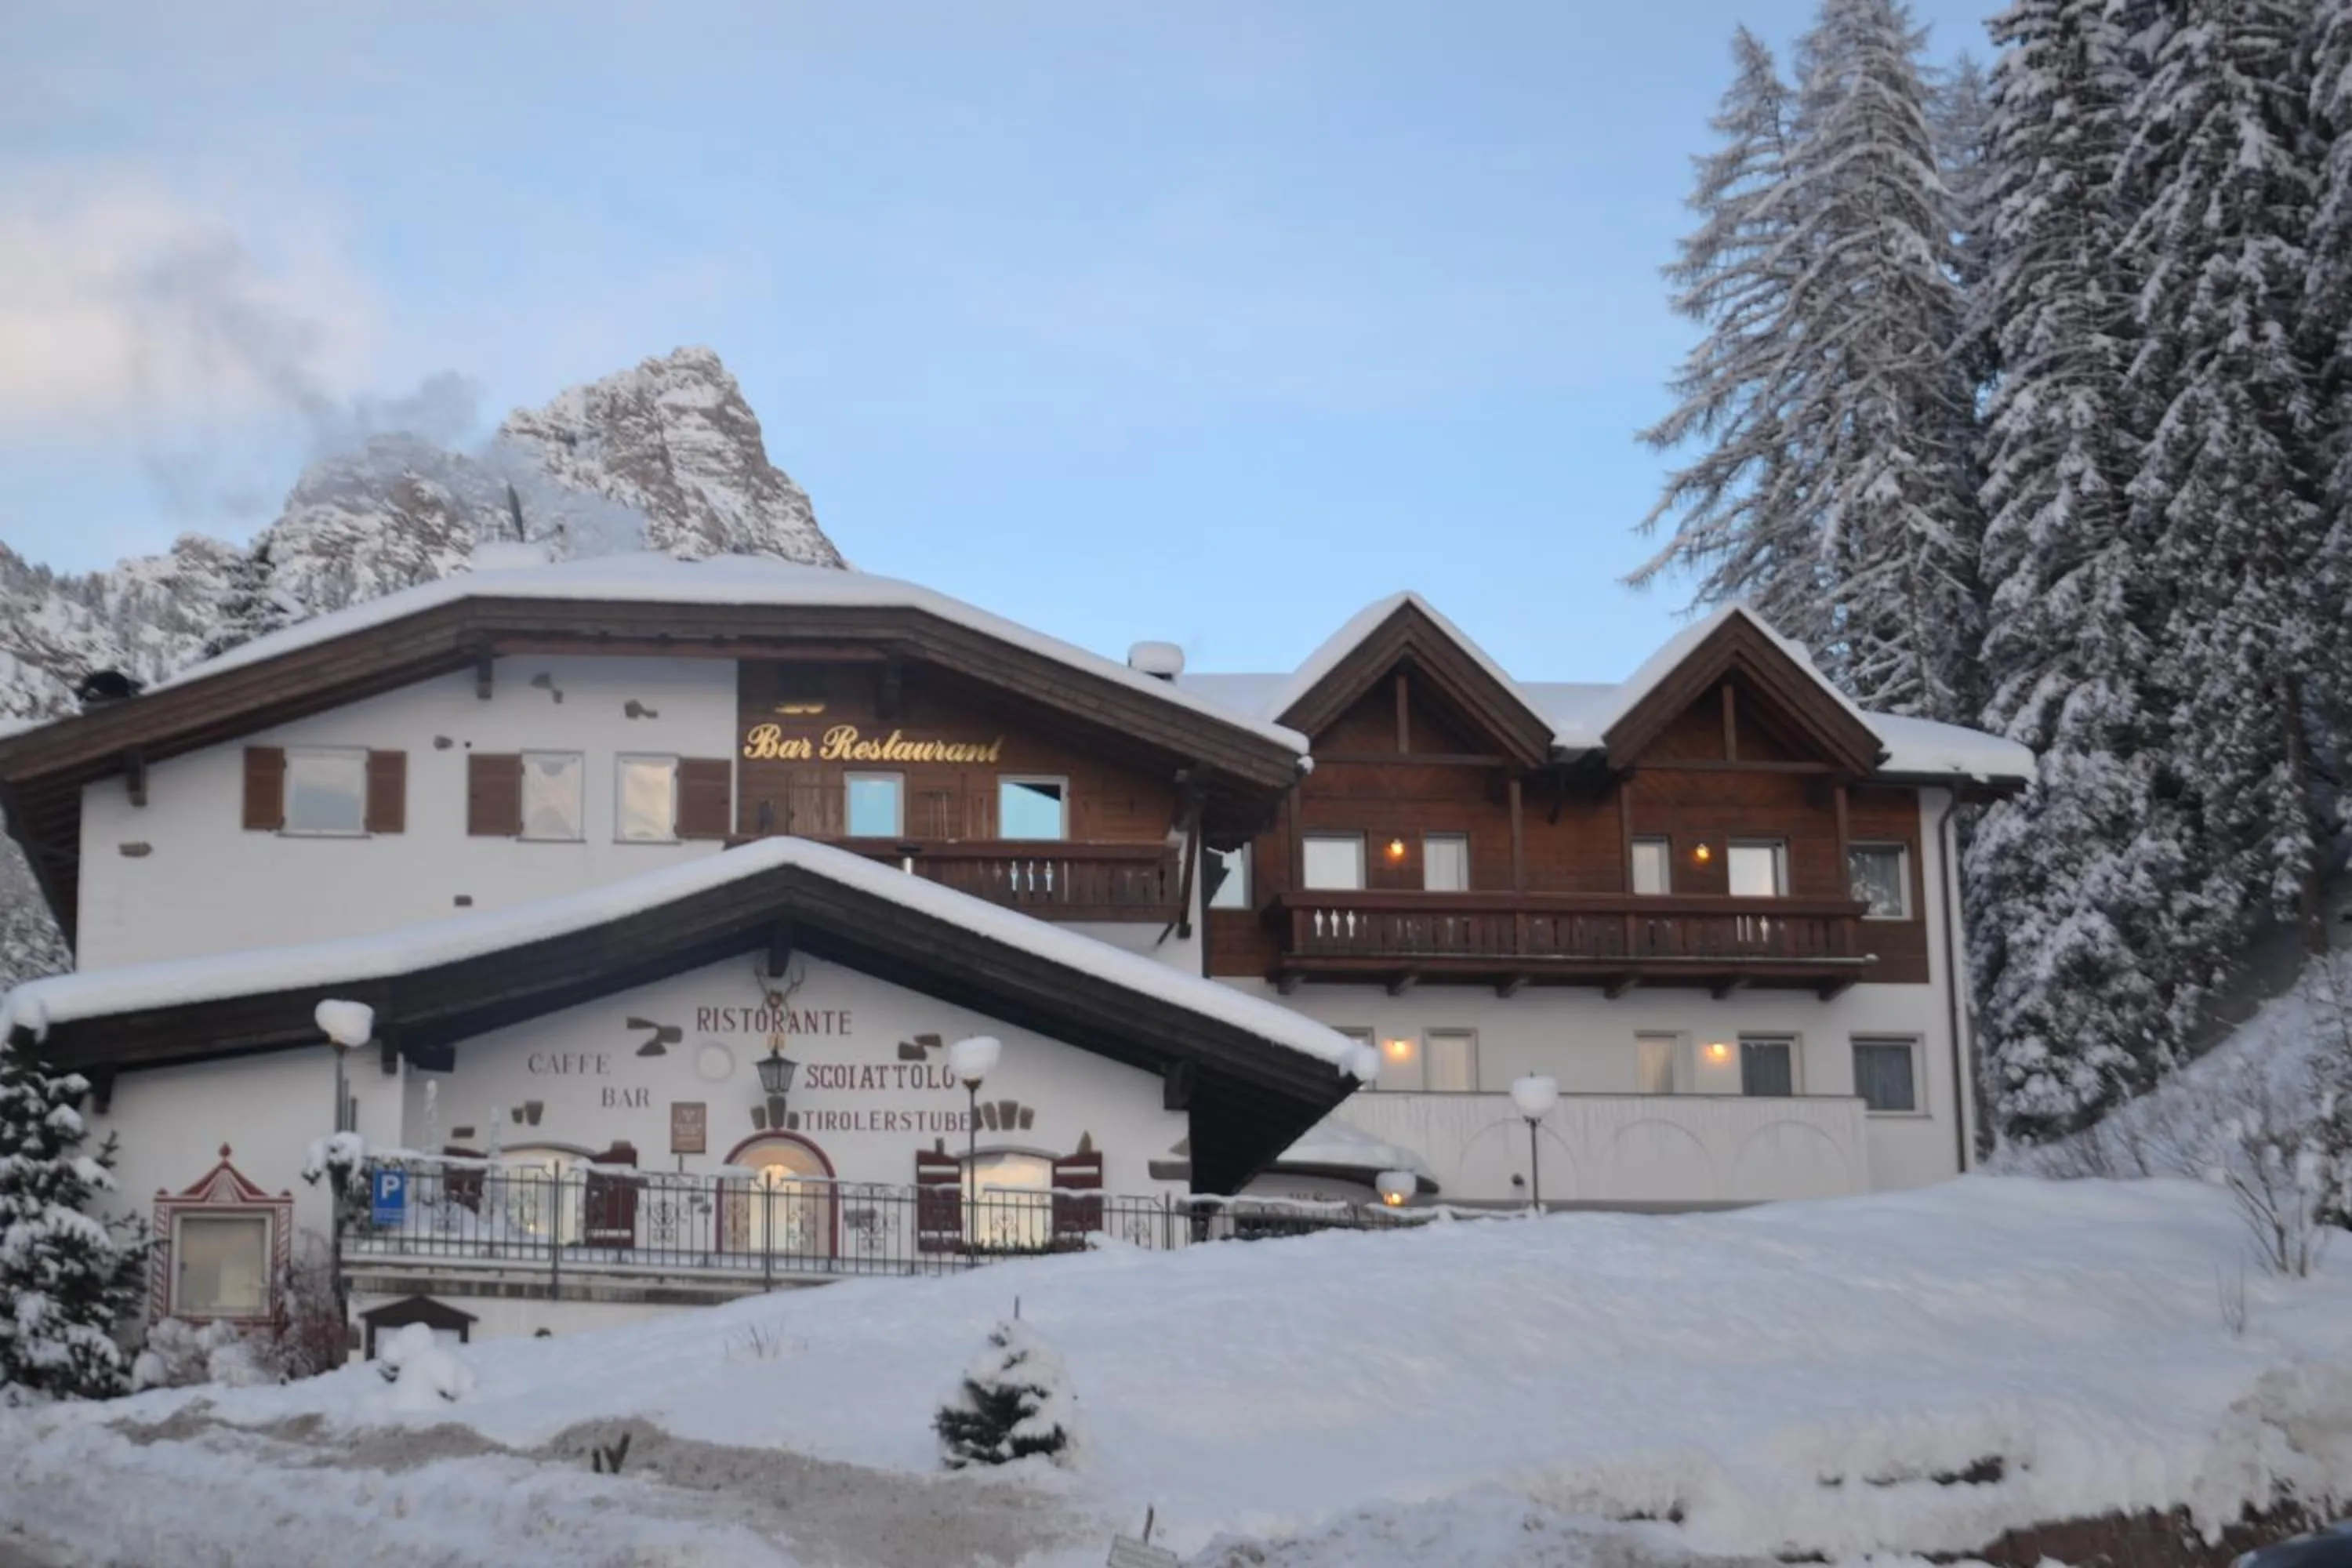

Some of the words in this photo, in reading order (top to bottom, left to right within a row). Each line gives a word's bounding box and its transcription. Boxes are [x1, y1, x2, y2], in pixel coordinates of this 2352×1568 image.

[743, 723, 811, 760] Bar
[819, 724, 1004, 763] Restaurant
[697, 1007, 853, 1035] RISTORANTE
[601, 1087, 649, 1109] BAR
[804, 1110, 971, 1132] TIROLERSTUBE
[381, 1174, 401, 1199] P
